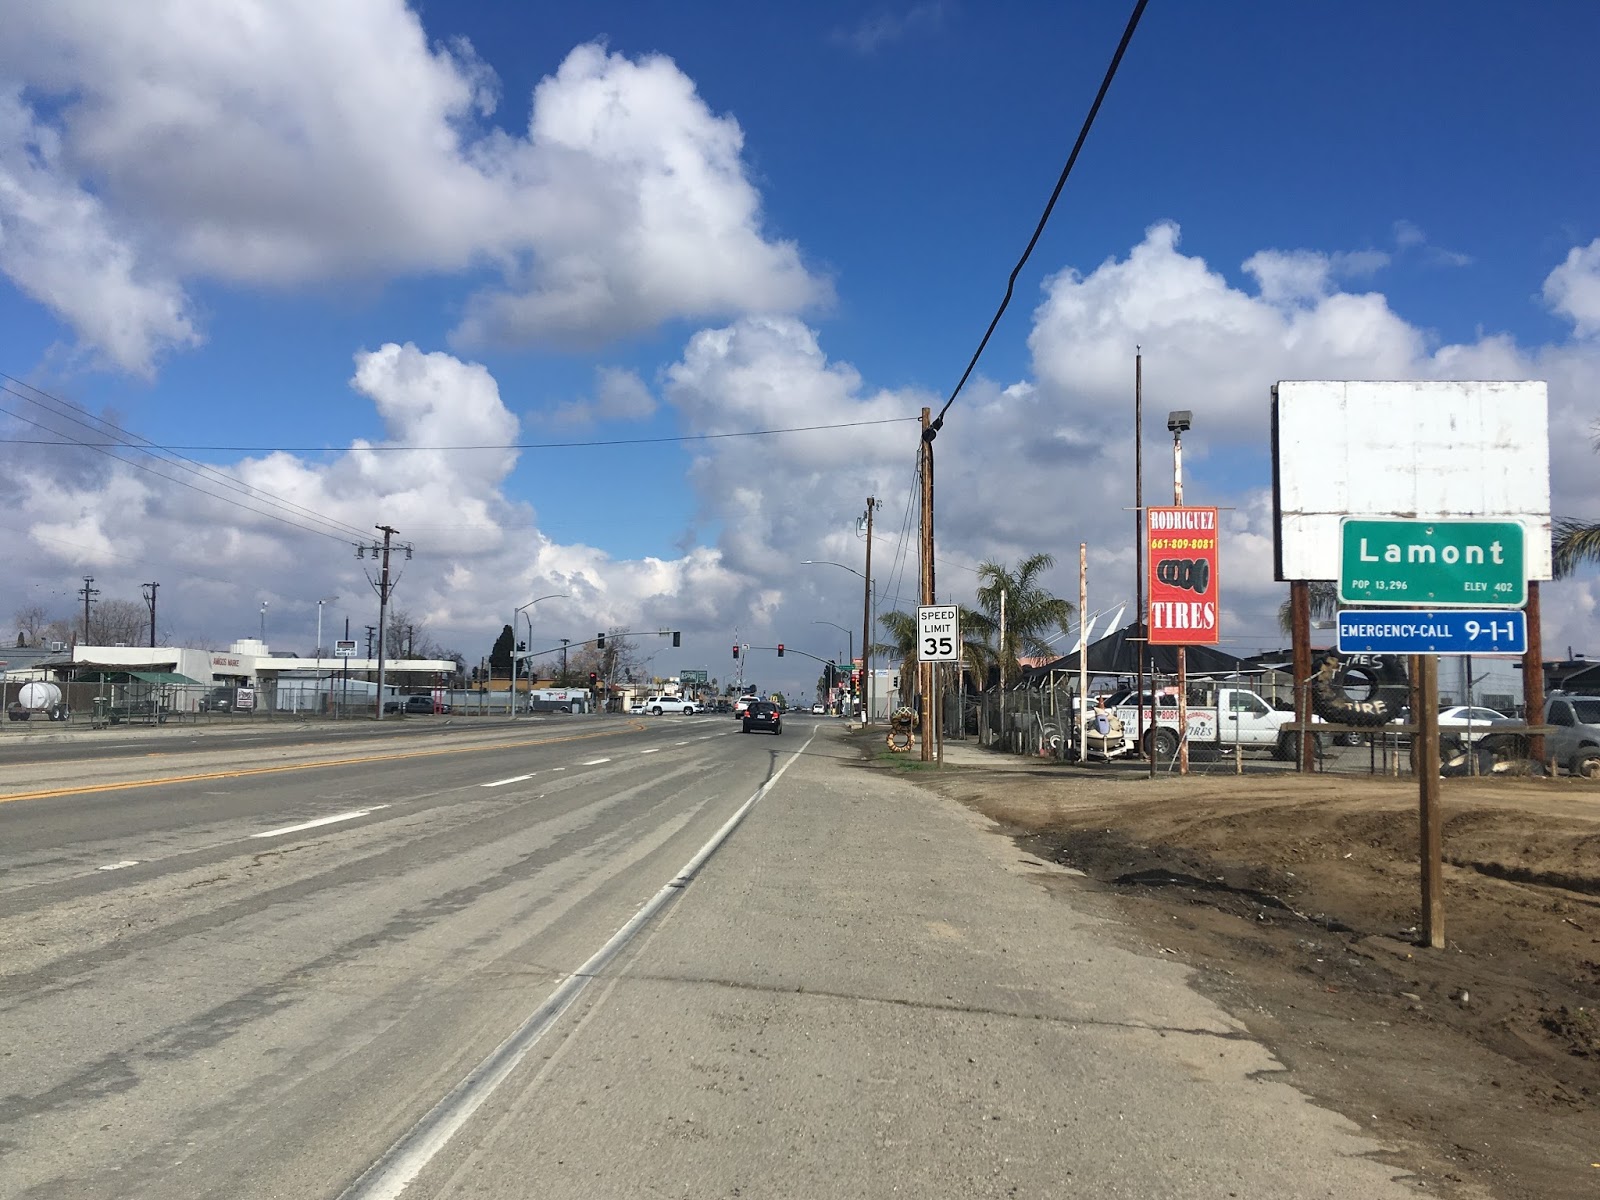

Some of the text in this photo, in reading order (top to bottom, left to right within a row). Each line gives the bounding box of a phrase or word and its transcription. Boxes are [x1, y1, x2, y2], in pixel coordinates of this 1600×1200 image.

[1151, 511, 1215, 530] RODRIGUEZ
[1151, 538, 1214, 549] 661-809-8081
[1360, 538, 1504, 564] Lamont
[1352, 580, 1408, 590] POP 13,296
[1464, 582, 1513, 592] ELEV 402
[921, 611, 955, 620] SPEED
[1152, 602, 1215, 629] TIRES
[924, 624, 951, 633] LIMIT
[1341, 620, 1514, 641] EMERGENCY-CALL 9-1-1
[924, 637, 952, 655] 35
[1344, 700, 1388, 714] TIRE
